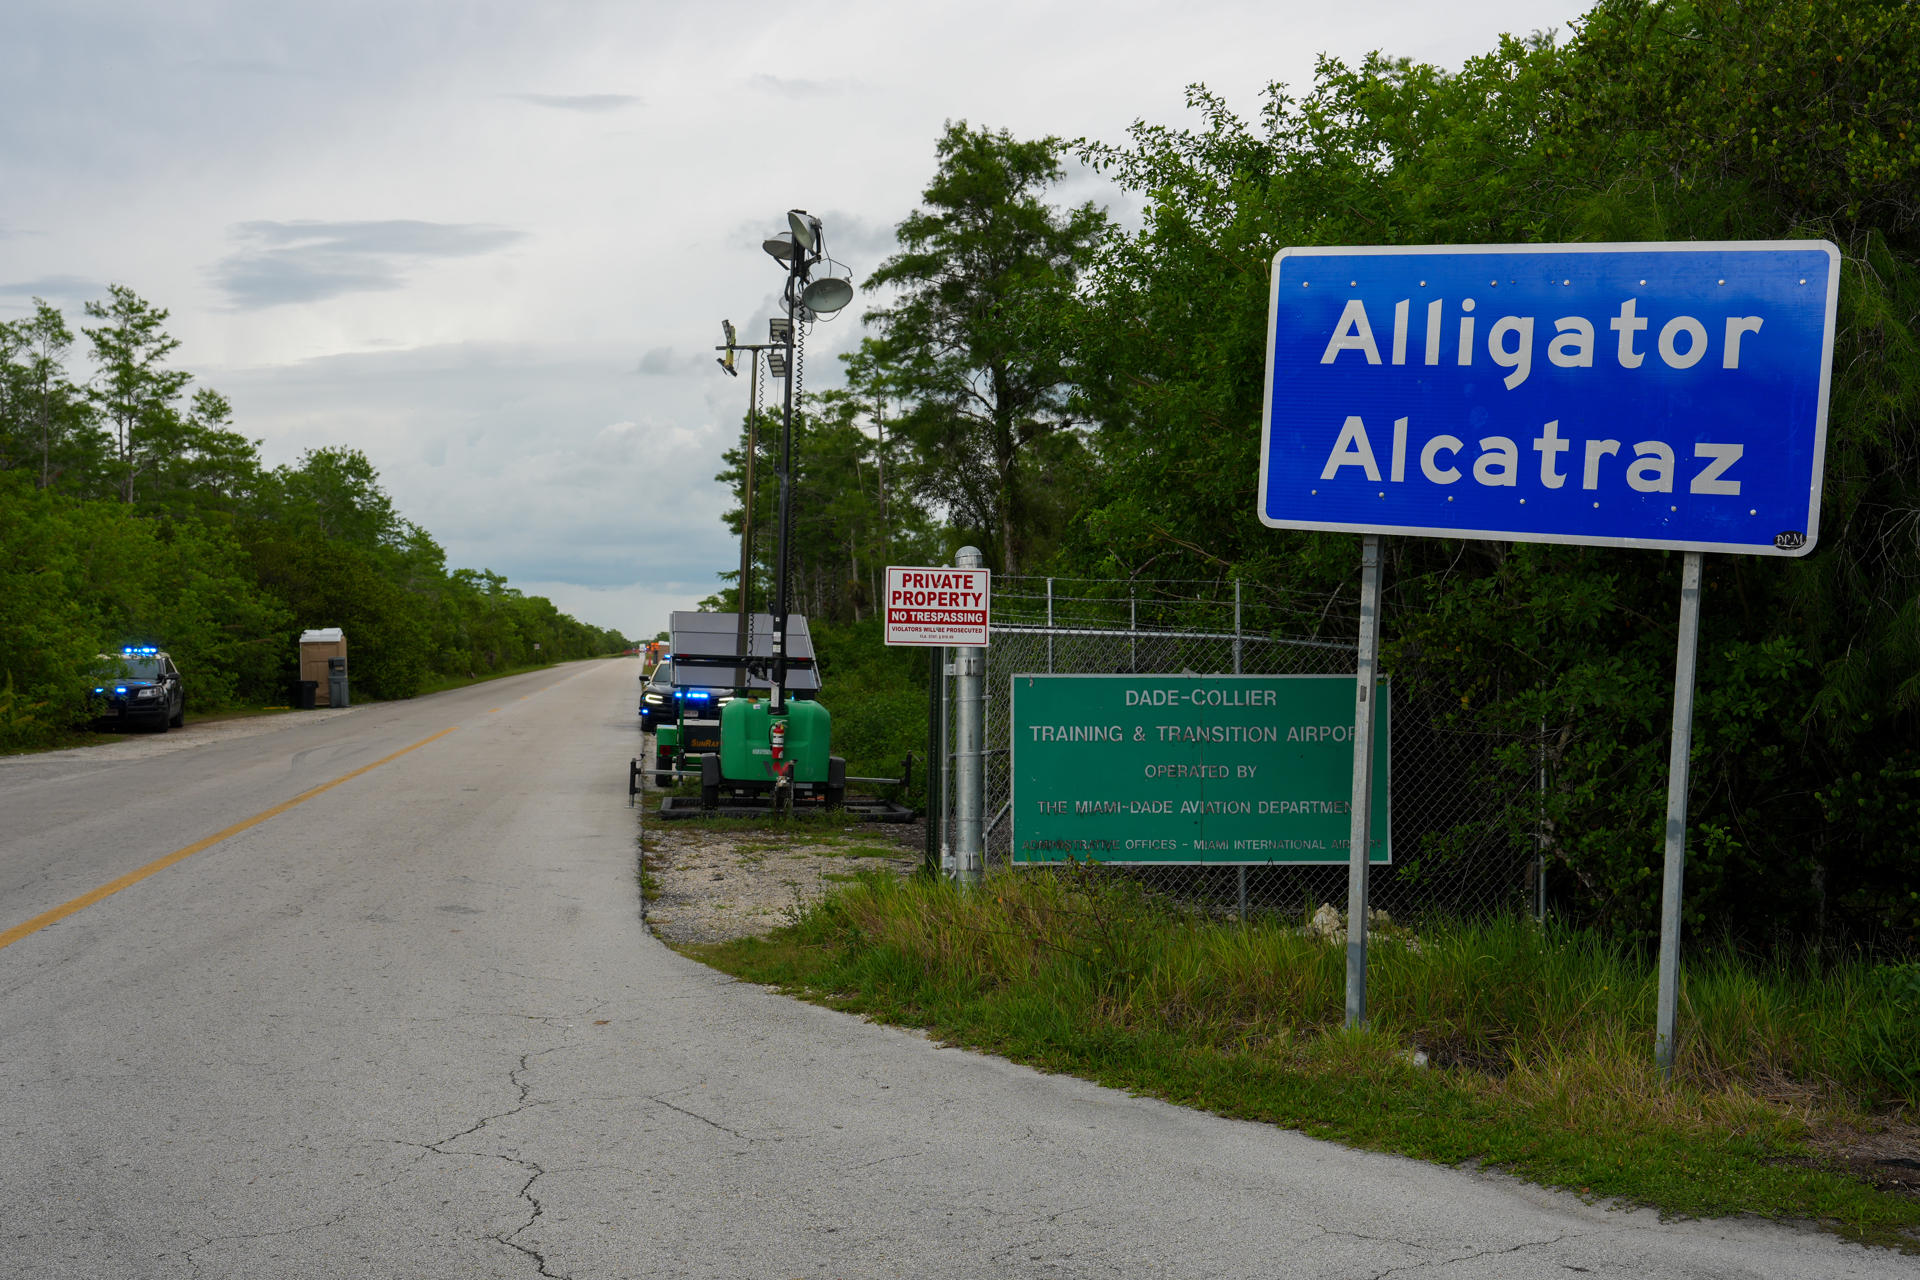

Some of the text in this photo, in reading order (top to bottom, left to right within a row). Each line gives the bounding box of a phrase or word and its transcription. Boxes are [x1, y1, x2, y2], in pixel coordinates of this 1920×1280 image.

[1320, 297, 1763, 391] Alligator
[1320, 415, 1744, 495] Alcatraz
[902, 573, 974, 589] PRIVATE
[892, 590, 983, 607] PROPERTY
[891, 611, 983, 623] NO TRESPASSING
[1125, 690, 1277, 706] DADE-COLLIER
[1029, 726, 1355, 742] TRAINING & TRANSITION AIRPOR
[1144, 765, 1257, 779] OPERATED BY
[1037, 801, 1353, 814] THE MIAMI-DADE AVIATION DEPARTMEN
[1125, 840, 1177, 850] OFFICES
[1194, 840, 1229, 850] MIAMI
[1234, 840, 1326, 850] INTERNATIONAL
